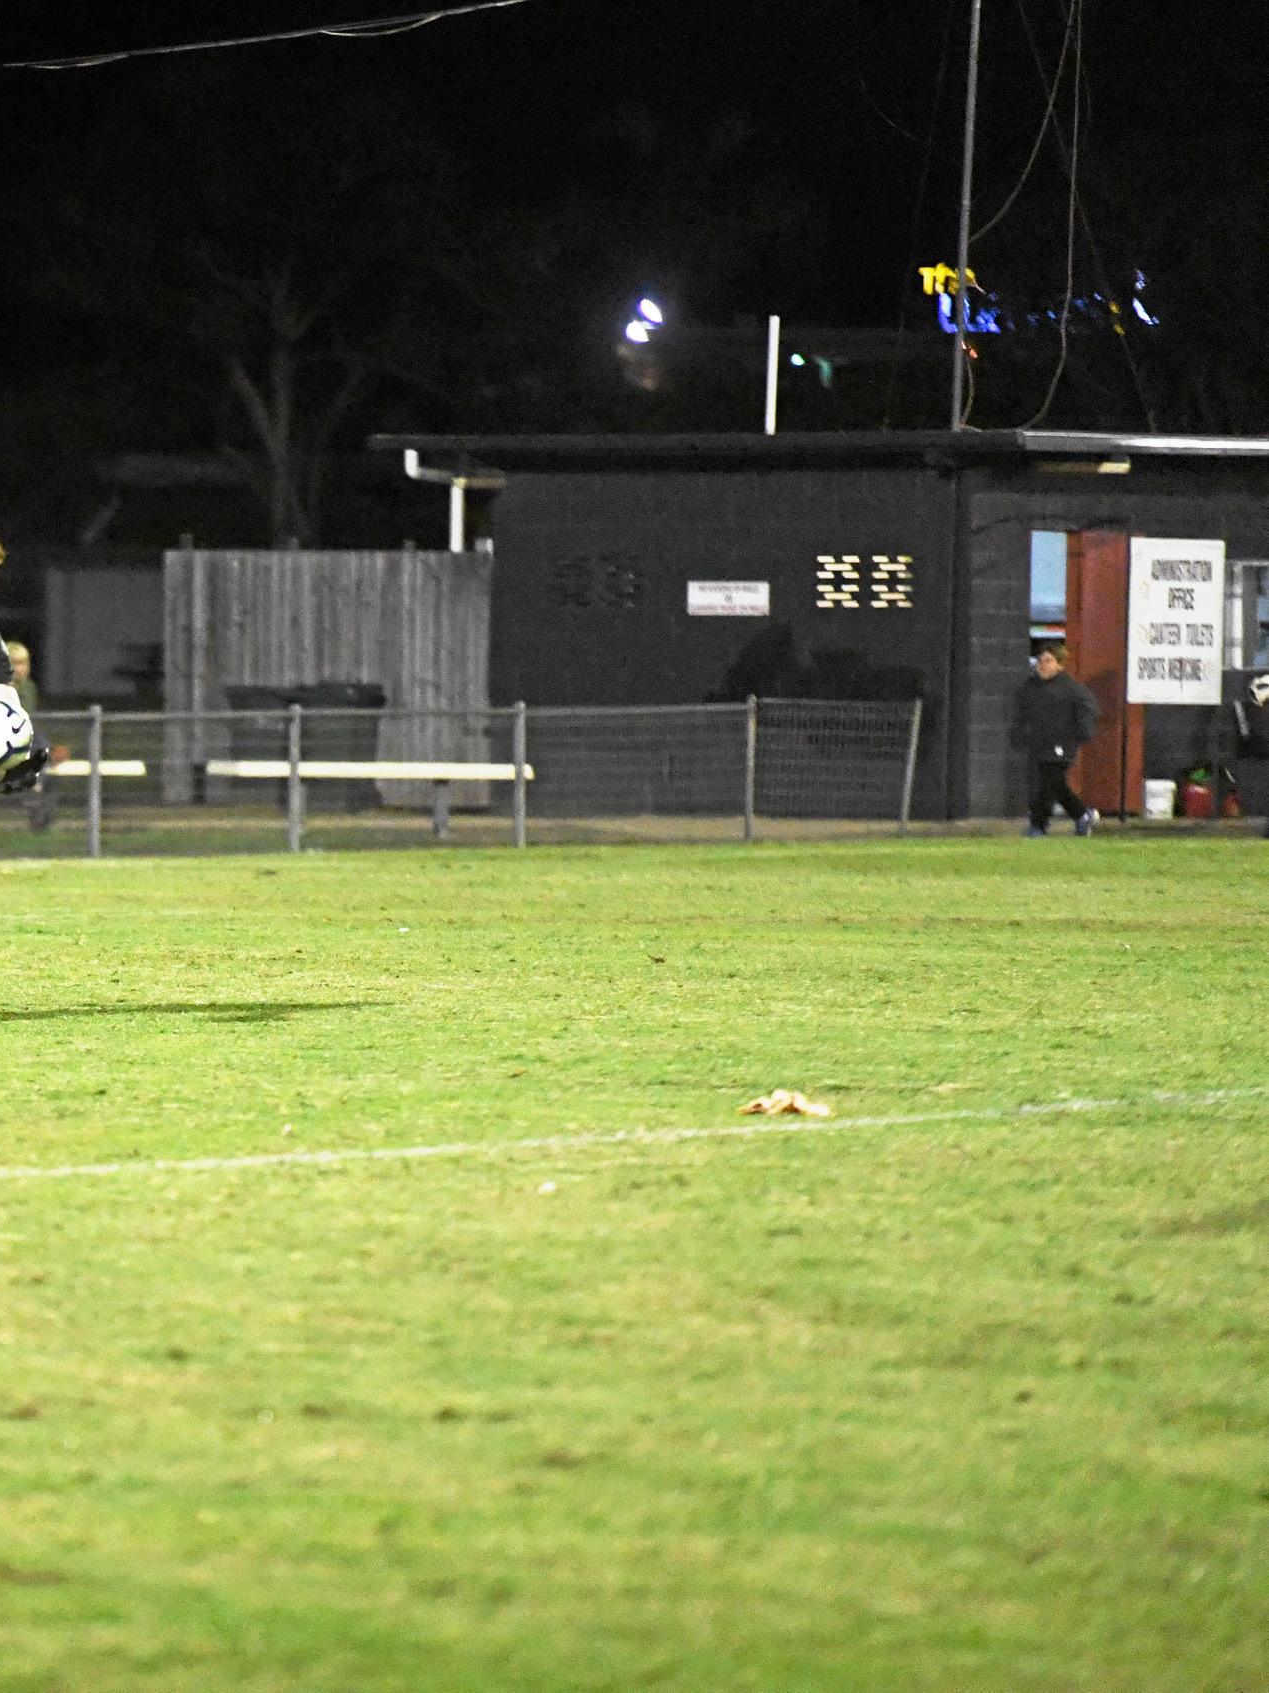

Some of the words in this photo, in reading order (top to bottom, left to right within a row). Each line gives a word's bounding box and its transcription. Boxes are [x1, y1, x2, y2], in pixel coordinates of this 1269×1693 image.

[1151, 558, 1213, 582] ADMINISTRATION
[1168, 586, 1195, 611] OFFICE
[1149, 621, 1181, 646] CANTEEN
[1186, 622, 1214, 647] TOILETS
[1138, 656, 1166, 681] SPORTS
[1167, 656, 1202, 682] MEDICINE
